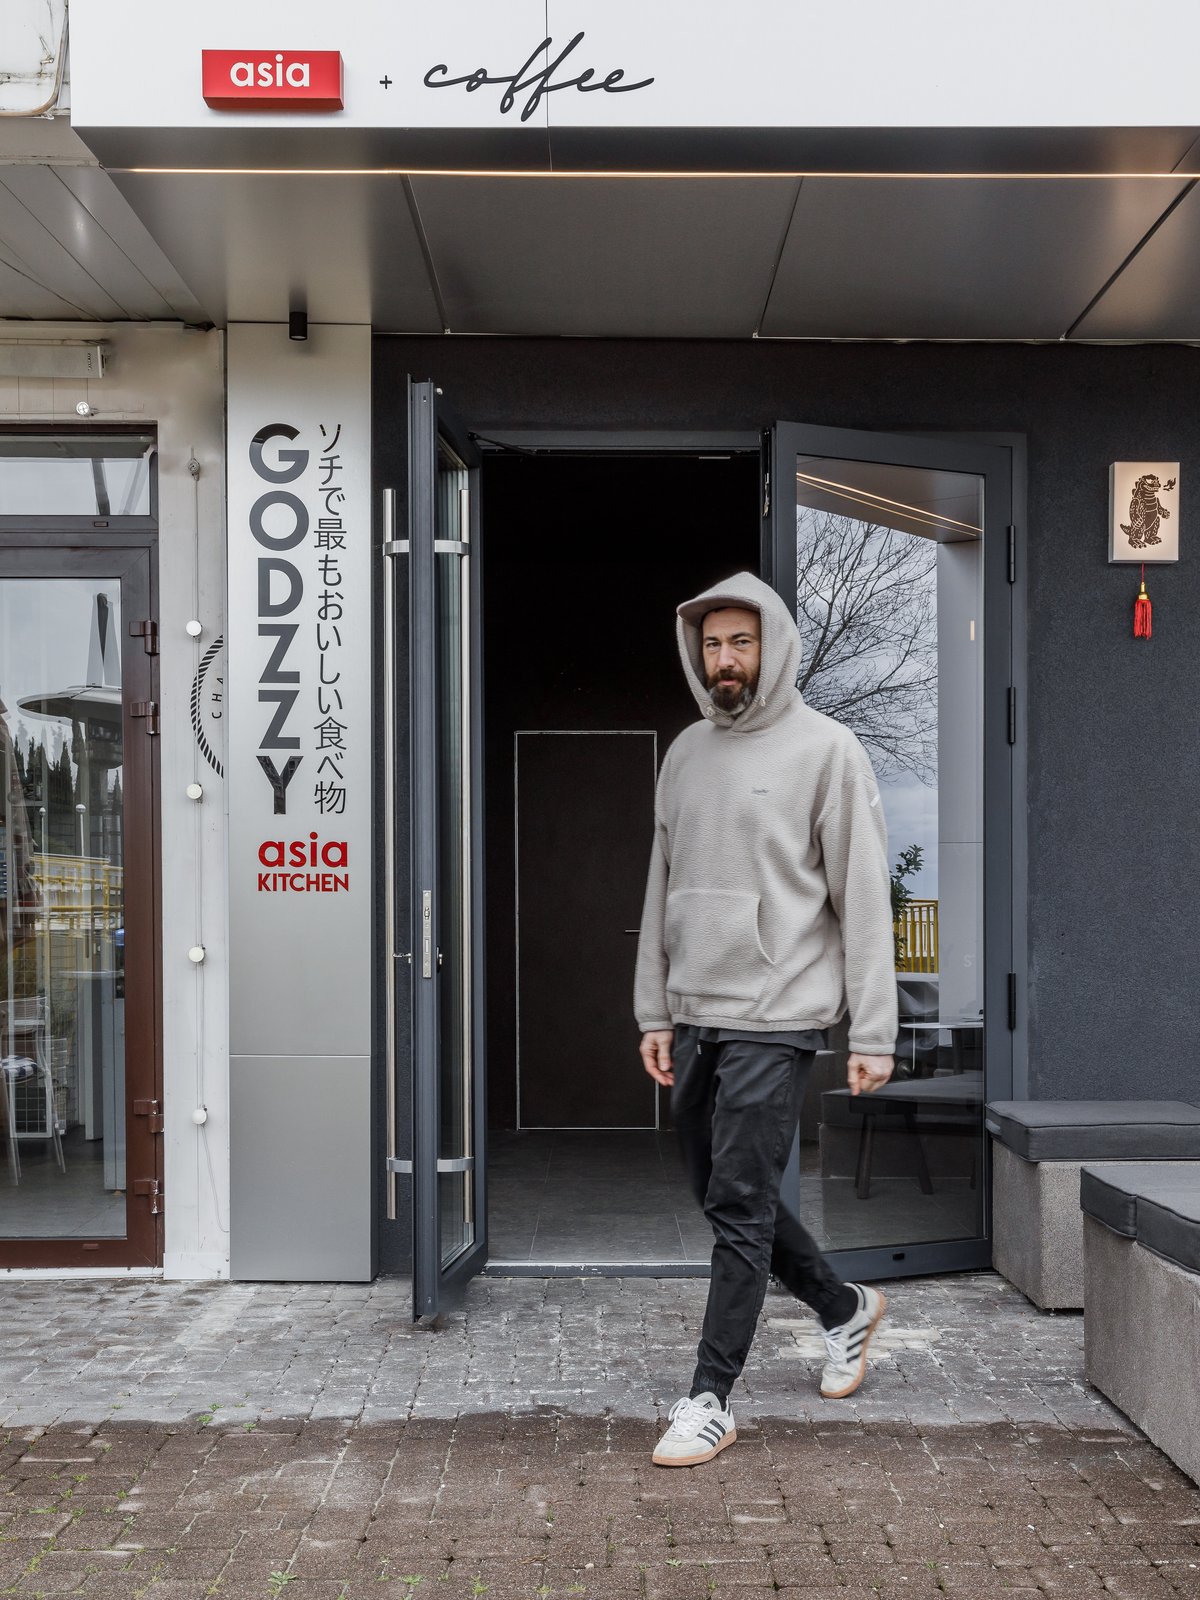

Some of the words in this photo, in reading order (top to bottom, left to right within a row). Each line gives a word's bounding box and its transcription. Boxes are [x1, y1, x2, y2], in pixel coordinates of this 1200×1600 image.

[229, 53, 310, 88] asia
[423, 31, 655, 122] coffee
[248, 422, 310, 815] GODZZY
[313, 423, 348, 815] ソチで最もおいしい食べ物
[257, 831, 348, 868] asia
[257, 873, 349, 893] KITCHEN
